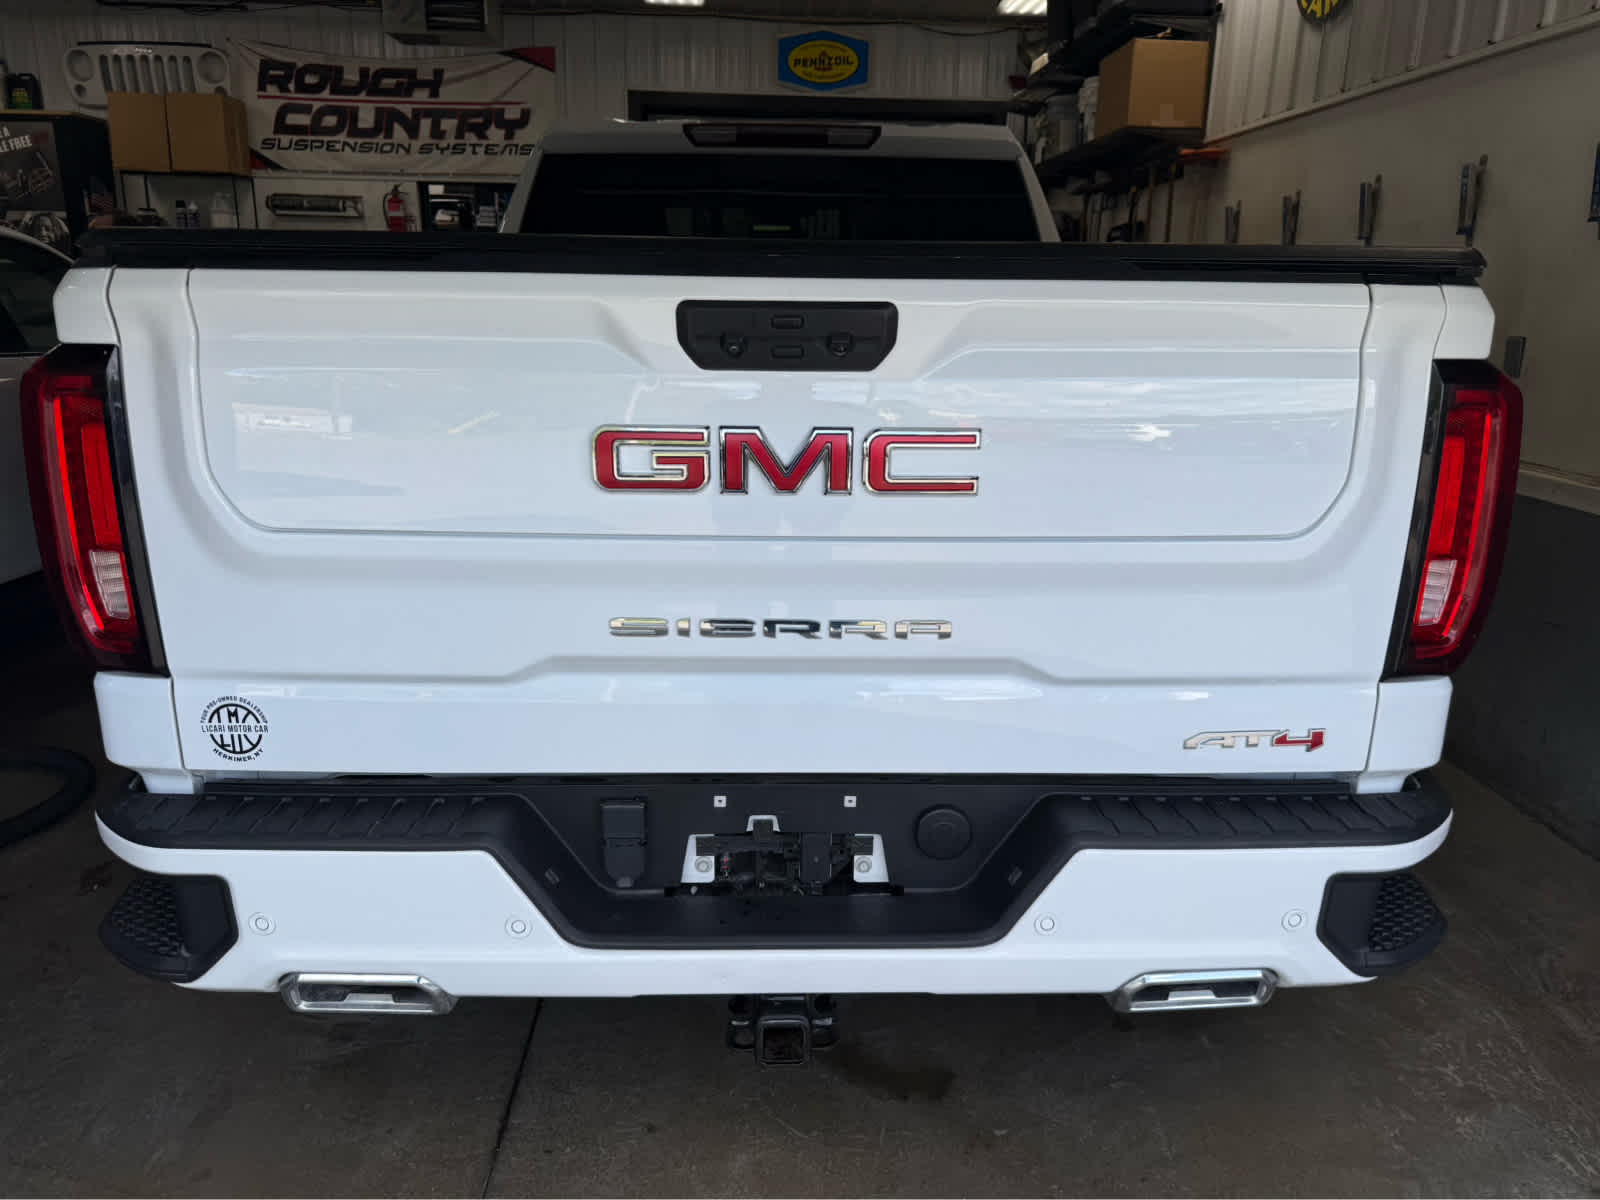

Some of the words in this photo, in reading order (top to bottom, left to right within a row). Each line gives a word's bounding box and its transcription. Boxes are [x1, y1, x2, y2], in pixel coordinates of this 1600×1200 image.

[794, 55, 853, 69] PENNZOIL
[257, 58, 444, 98] ROUGH
[273, 103, 531, 140] COUNTRY
[8, 135, 33, 151] FREE
[261, 138, 411, 154] SUSPENSION
[417, 142, 535, 155] SYSTEMS
[592, 424, 982, 496] GMC
[609, 616, 953, 640] SIERRA
[239, 697, 268, 724] DEALERSHIP
[201, 724, 225, 733] LICARI
[227, 724, 252, 733] MOTOR
[254, 724, 268, 733] CAR
[1183, 728, 1326, 752] AT4
